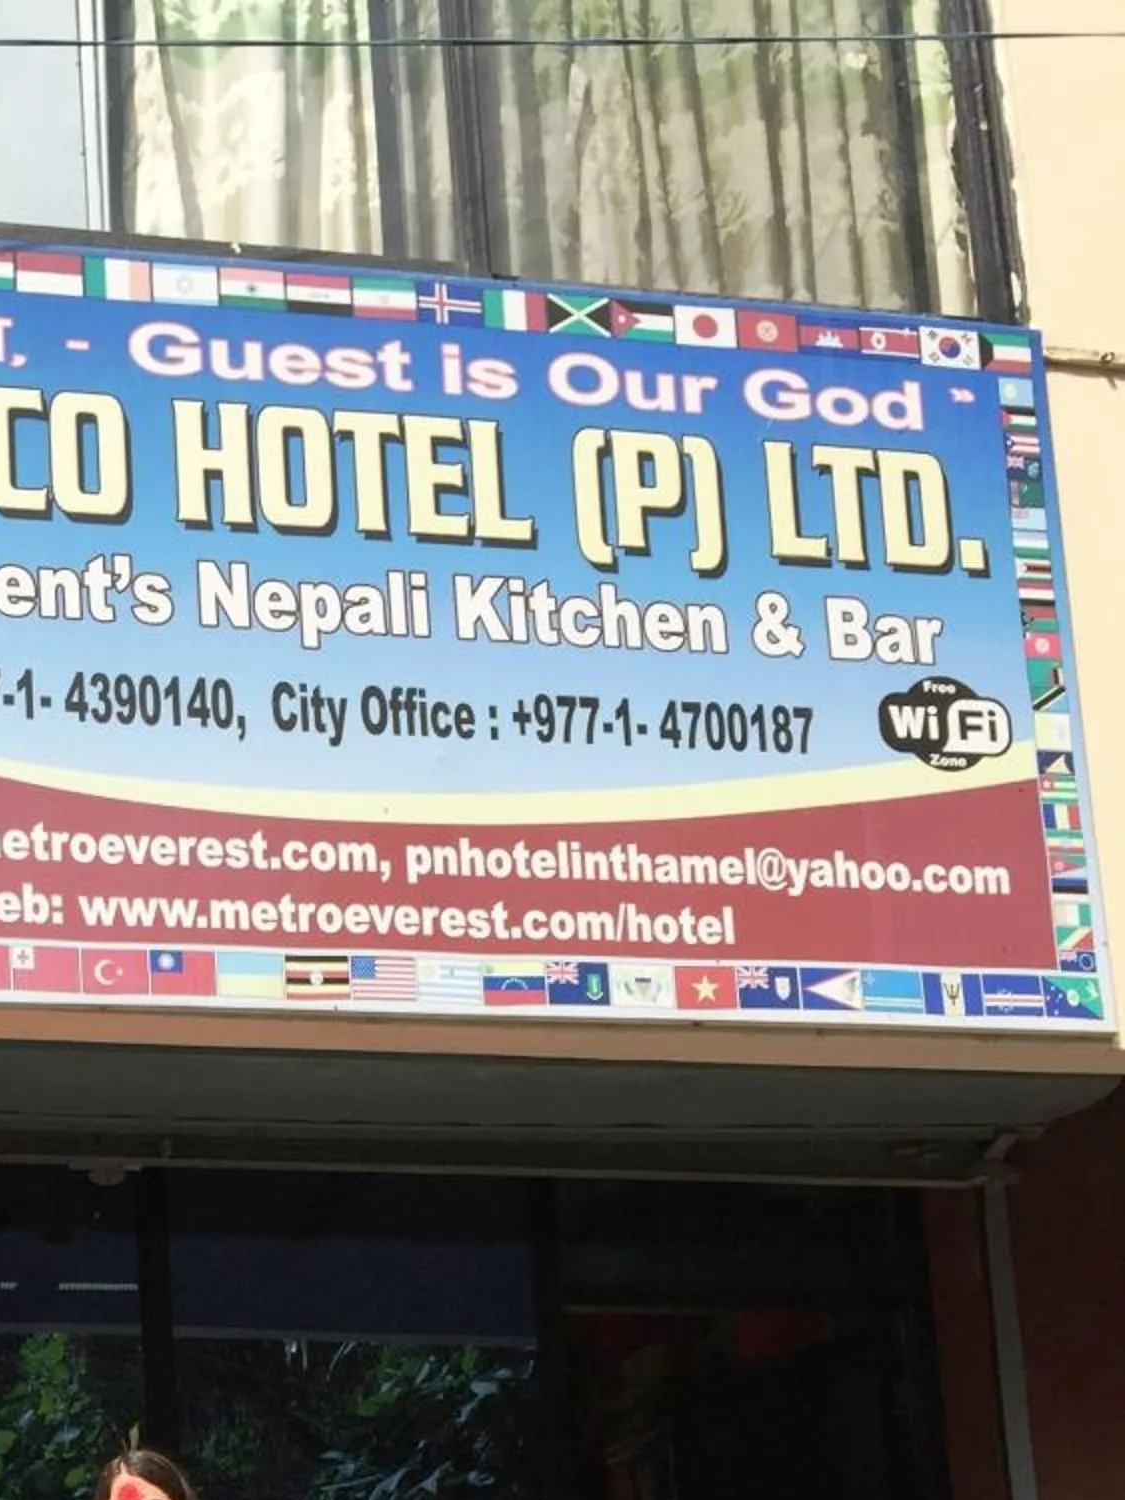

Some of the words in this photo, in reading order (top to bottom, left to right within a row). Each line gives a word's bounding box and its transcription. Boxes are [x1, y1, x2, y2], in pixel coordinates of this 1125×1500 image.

[128, 321, 413, 392] Guest
[442, 343, 518, 398] is
[547, 351, 718, 415] Our
[743, 369, 925, 432] God
[171, 397, 538, 550] HOTEL
[571, 425, 727, 578] (P)
[762, 440, 992, 580] LTD.
[197, 560, 431, 650] Nepali
[452, 572, 729, 655] Kitchen
[752, 590, 806, 662] &
[825, 595, 944, 667] Bar
[64, 670, 248, 741] 4390140,
[272, 680, 349, 747] City
[360, 686, 477, 740] Office
[659, 700, 815, 755] 4700187
[922, 680, 956, 694] Free
[930, 752, 967, 768] Zone
[406, 842, 1011, 896] pnhotelinthamel@yahoo.com
[78, 893, 735, 945] www.metroeverest.com/hotel
